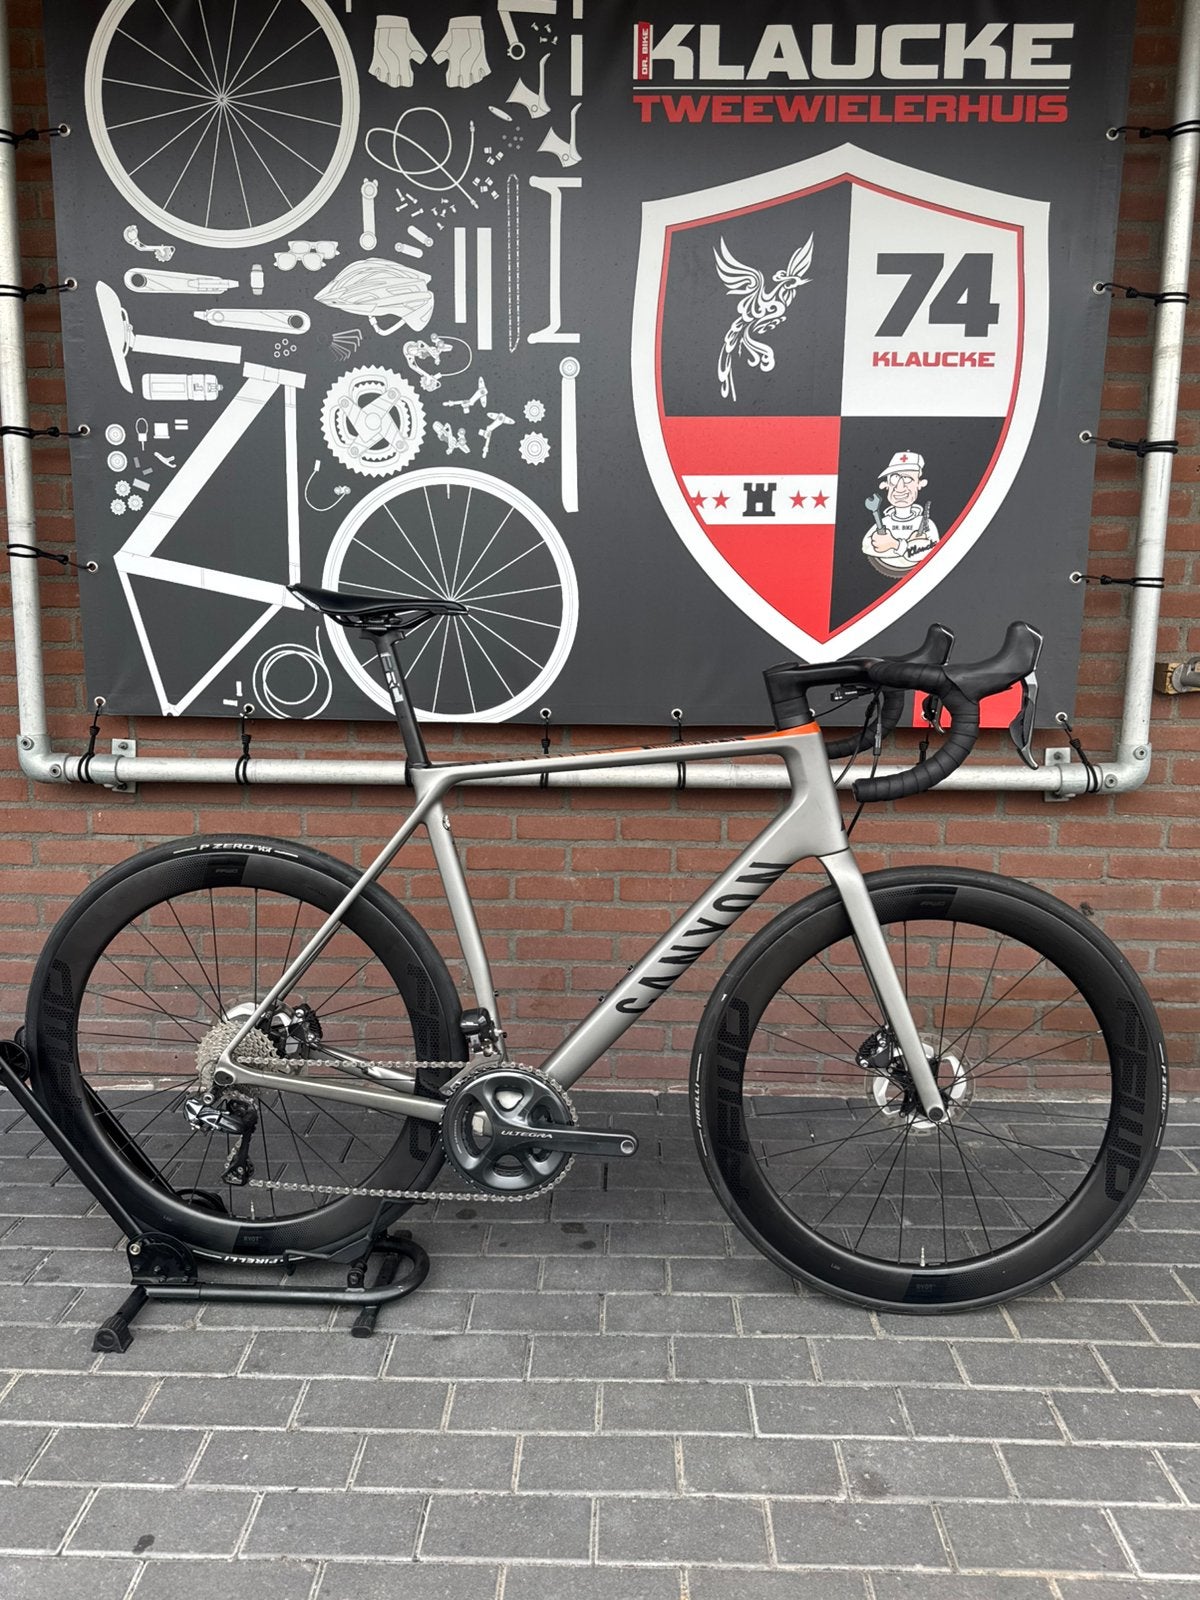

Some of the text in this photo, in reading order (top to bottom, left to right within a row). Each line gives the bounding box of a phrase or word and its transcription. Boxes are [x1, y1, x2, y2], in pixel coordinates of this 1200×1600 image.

[633, 23, 1074, 80] KLAUCKE
[641, 28, 649, 75] DR. BIKE
[633, 95, 1069, 124] TWEEWIELERHUIS
[874, 253, 1000, 337] 74
[872, 351, 996, 368] KLAUCKE
[615, 862, 793, 1014] CANYON
[694, 1082, 702, 1128] PIRELLI
[501, 1130, 553, 1139] ULTEGRA
[223, 1255, 279, 1264] PIRELLI
